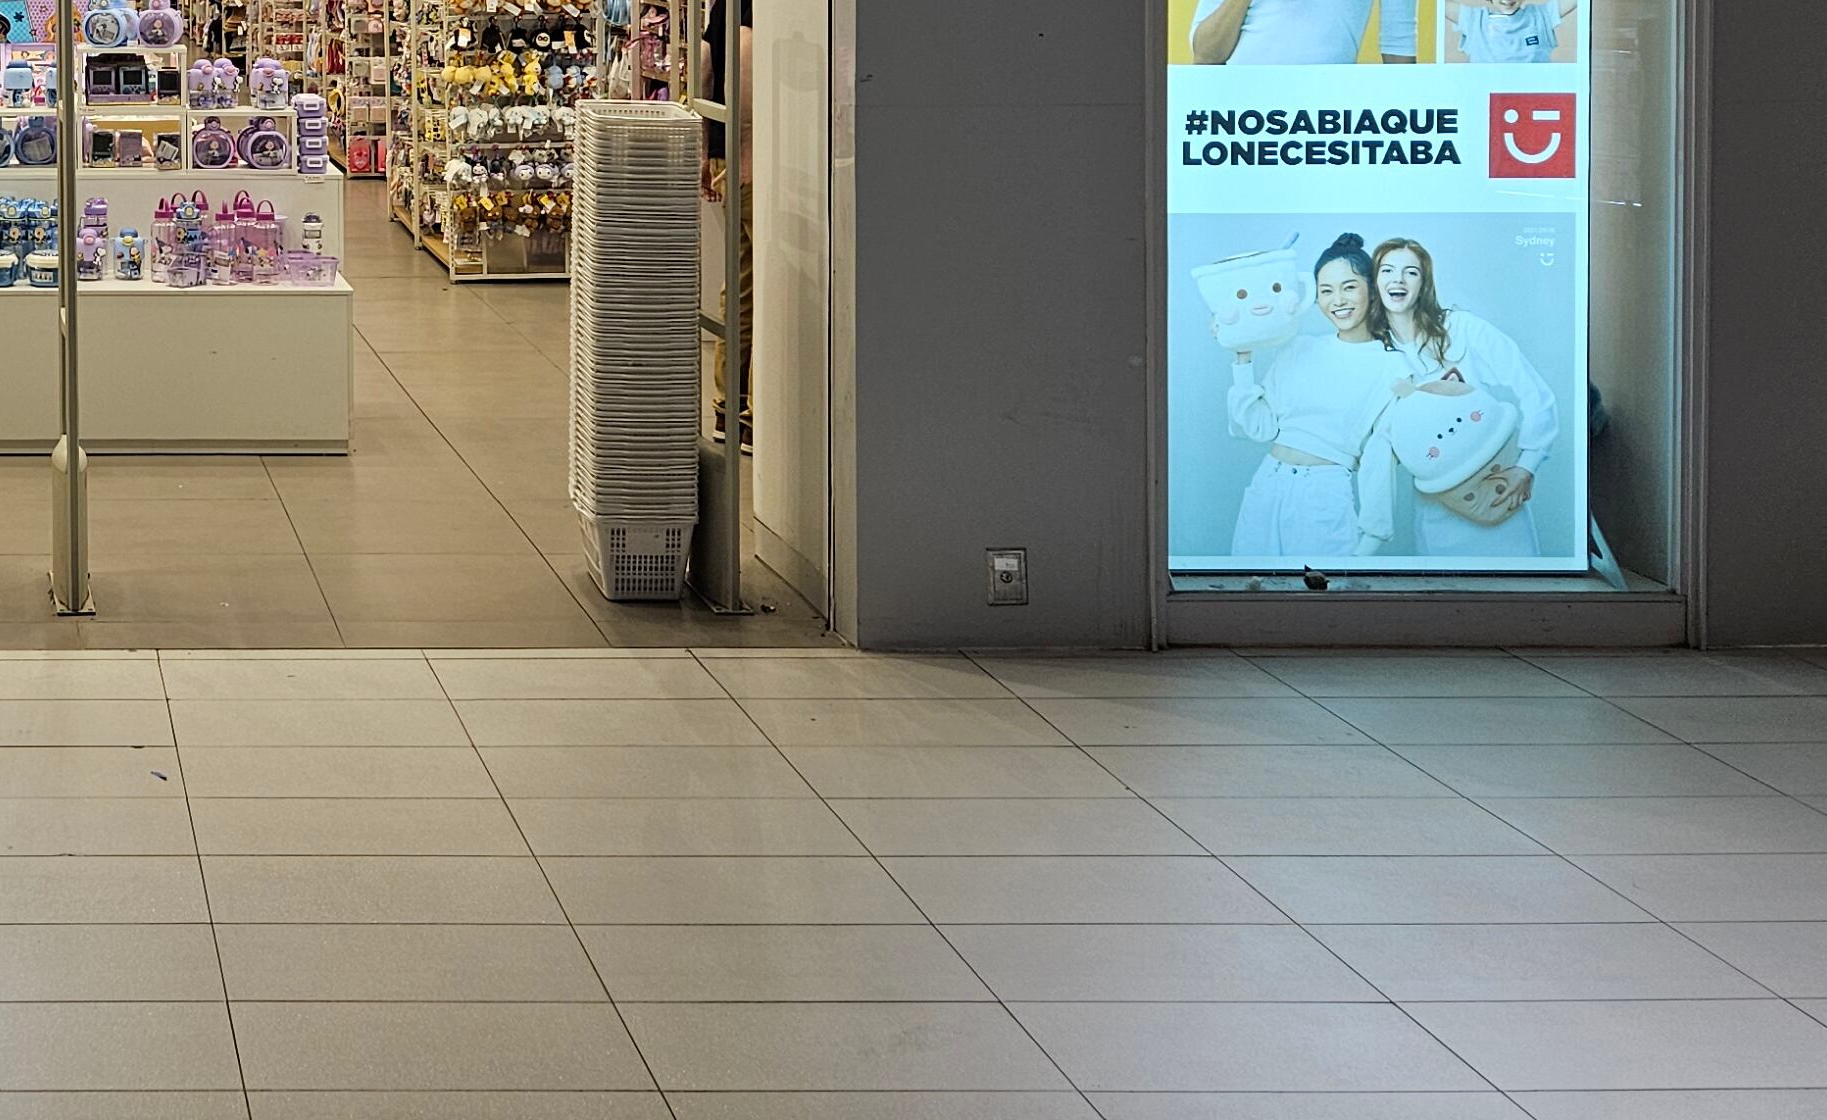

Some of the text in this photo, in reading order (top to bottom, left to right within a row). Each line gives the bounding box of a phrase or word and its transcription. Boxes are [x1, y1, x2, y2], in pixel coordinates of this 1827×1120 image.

[1184, 108, 1459, 136] #NOSABIAQUE
[1182, 140, 1462, 166] LONECESITABA
[1516, 235, 1555, 248] Sydney
